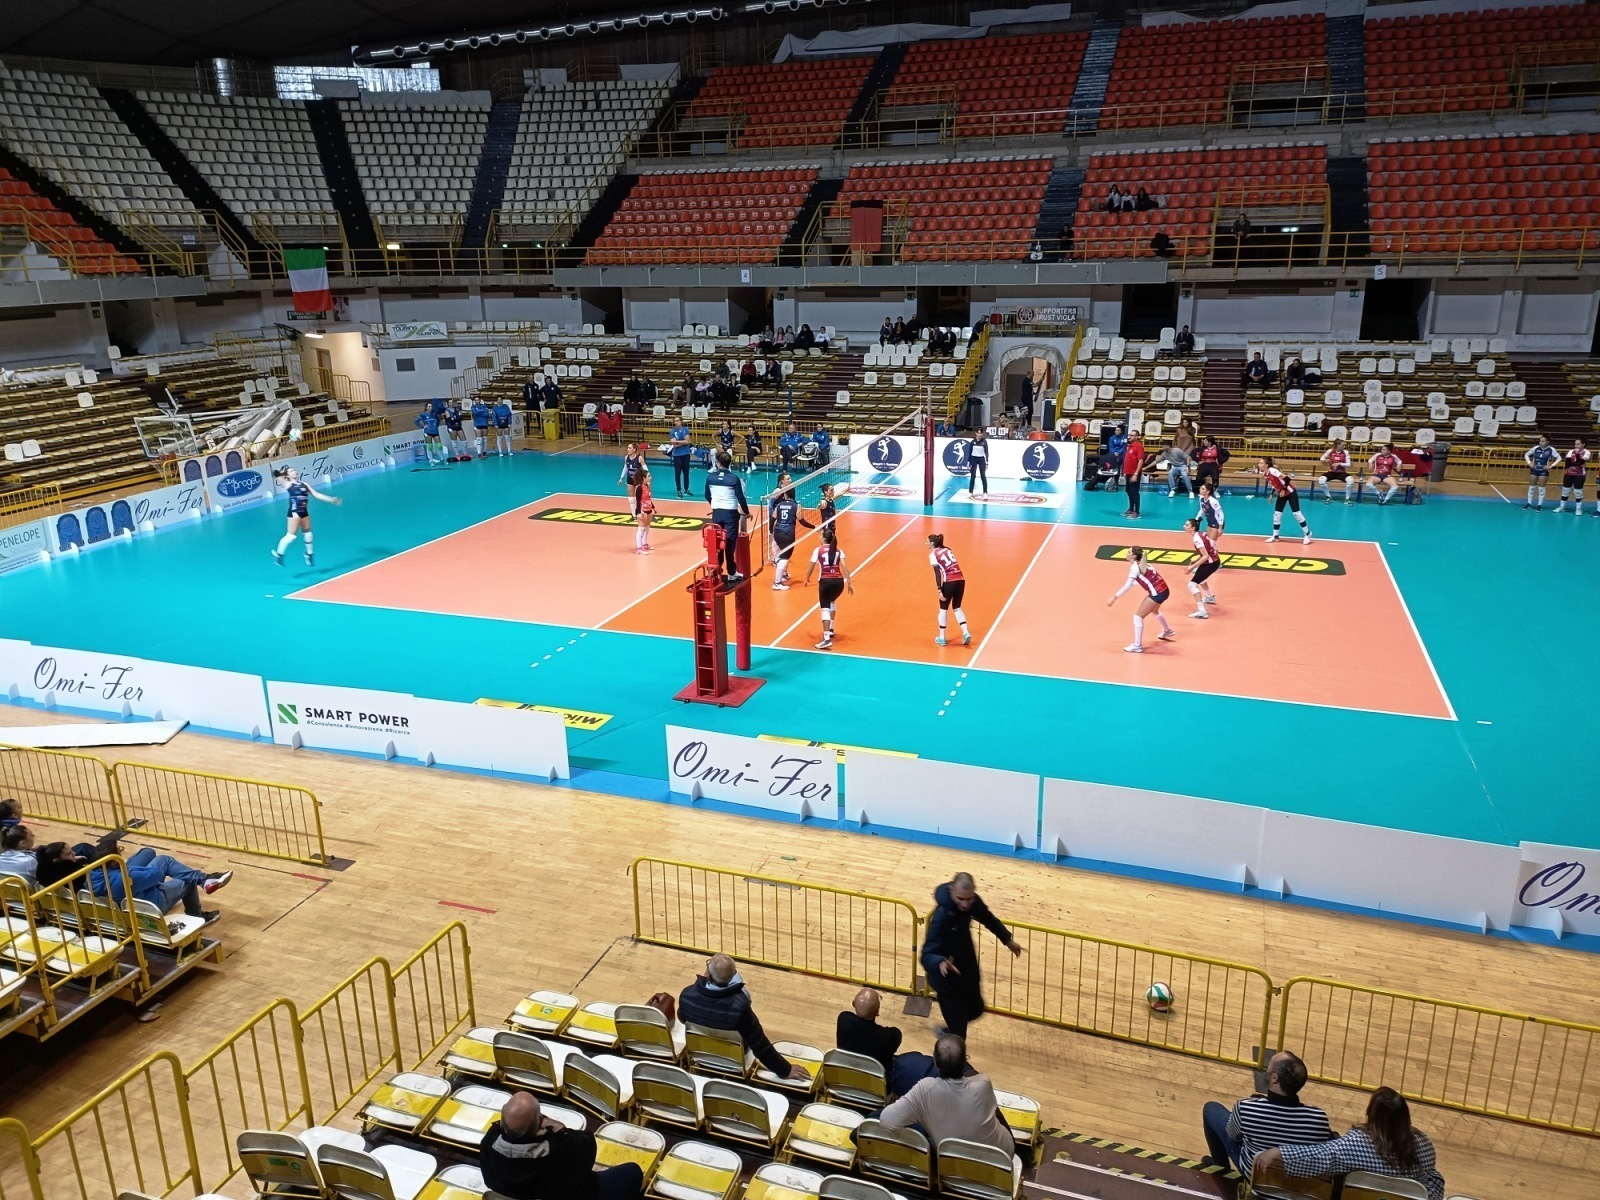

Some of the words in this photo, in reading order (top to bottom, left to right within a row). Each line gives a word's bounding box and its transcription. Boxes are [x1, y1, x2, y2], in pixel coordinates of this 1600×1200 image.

[393, 441, 411, 450] SMART
[135, 485, 203, 524] Omi-Fer
[781, 510, 789, 520] 15
[541, 510, 704, 528] CRDEM
[1110, 547, 1329, 572] CREEM
[34, 657, 144, 702] Omi-Fer
[305, 707, 352, 722] SMART
[358, 712, 409, 728] POWER
[672, 740, 833, 802] Omi-Fer
